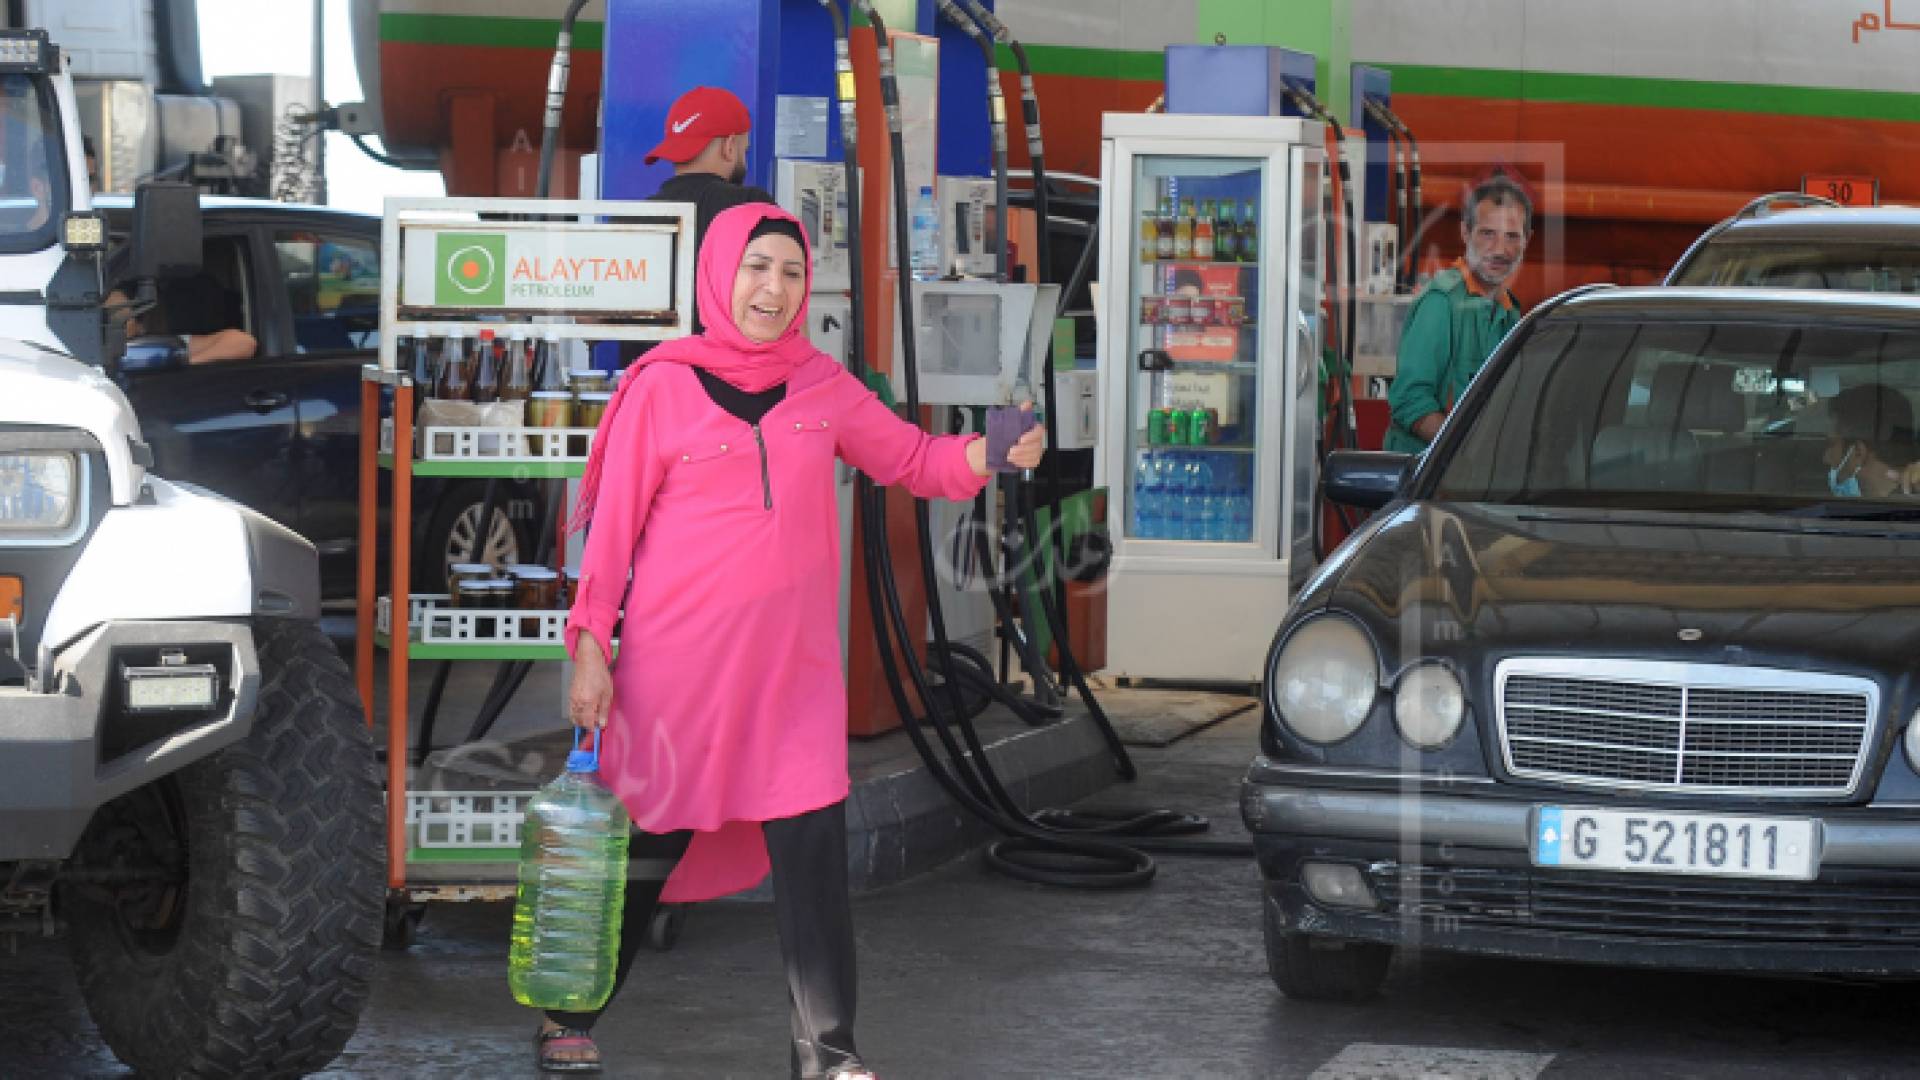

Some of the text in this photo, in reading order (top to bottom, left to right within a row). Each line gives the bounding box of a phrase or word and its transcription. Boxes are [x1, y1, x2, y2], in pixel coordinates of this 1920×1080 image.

[512, 256, 647, 281] ALAYTAM
[511, 283, 595, 298] PETROLEUM
[1573, 816, 1778, 870] G 521811
